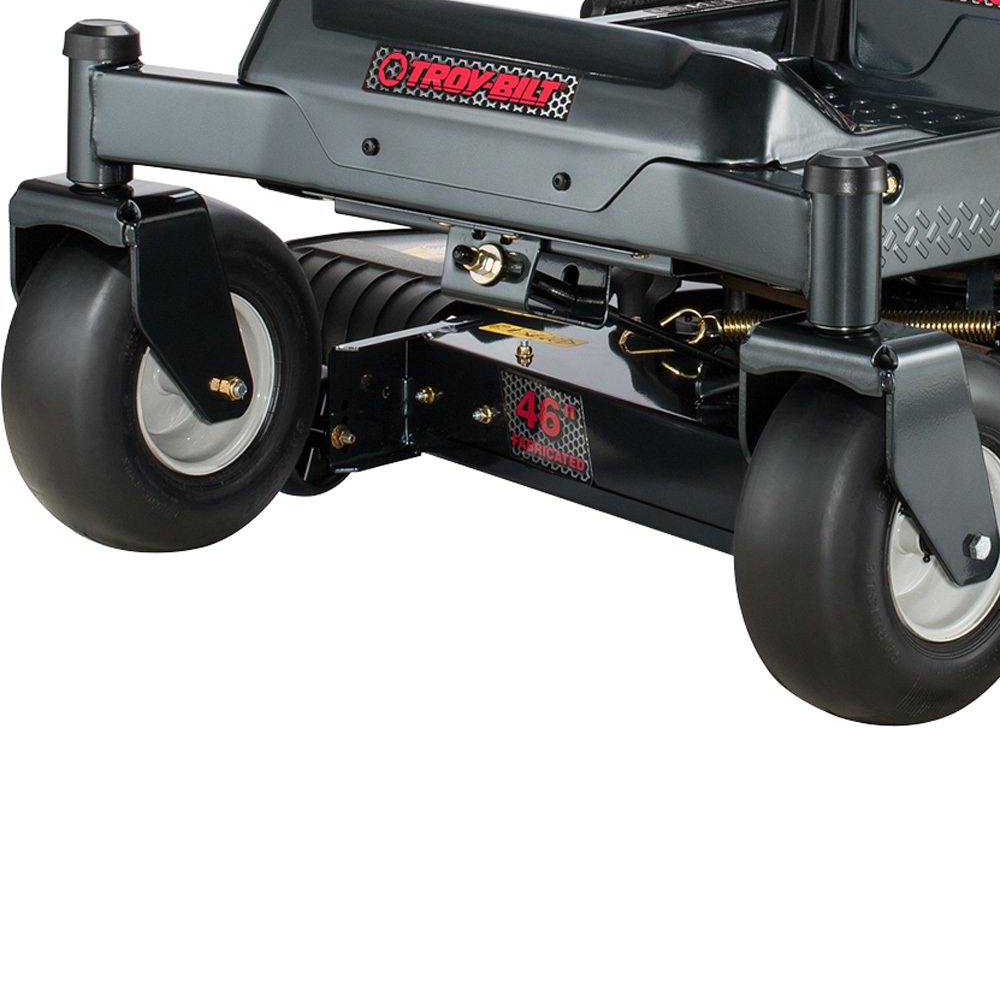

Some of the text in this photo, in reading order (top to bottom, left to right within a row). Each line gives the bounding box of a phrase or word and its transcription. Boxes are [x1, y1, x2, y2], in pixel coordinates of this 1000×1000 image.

[406, 60, 566, 107] TROY-BILT
[516, 391, 576, 438] 46"
[512, 433, 586, 473] FABRICATED
